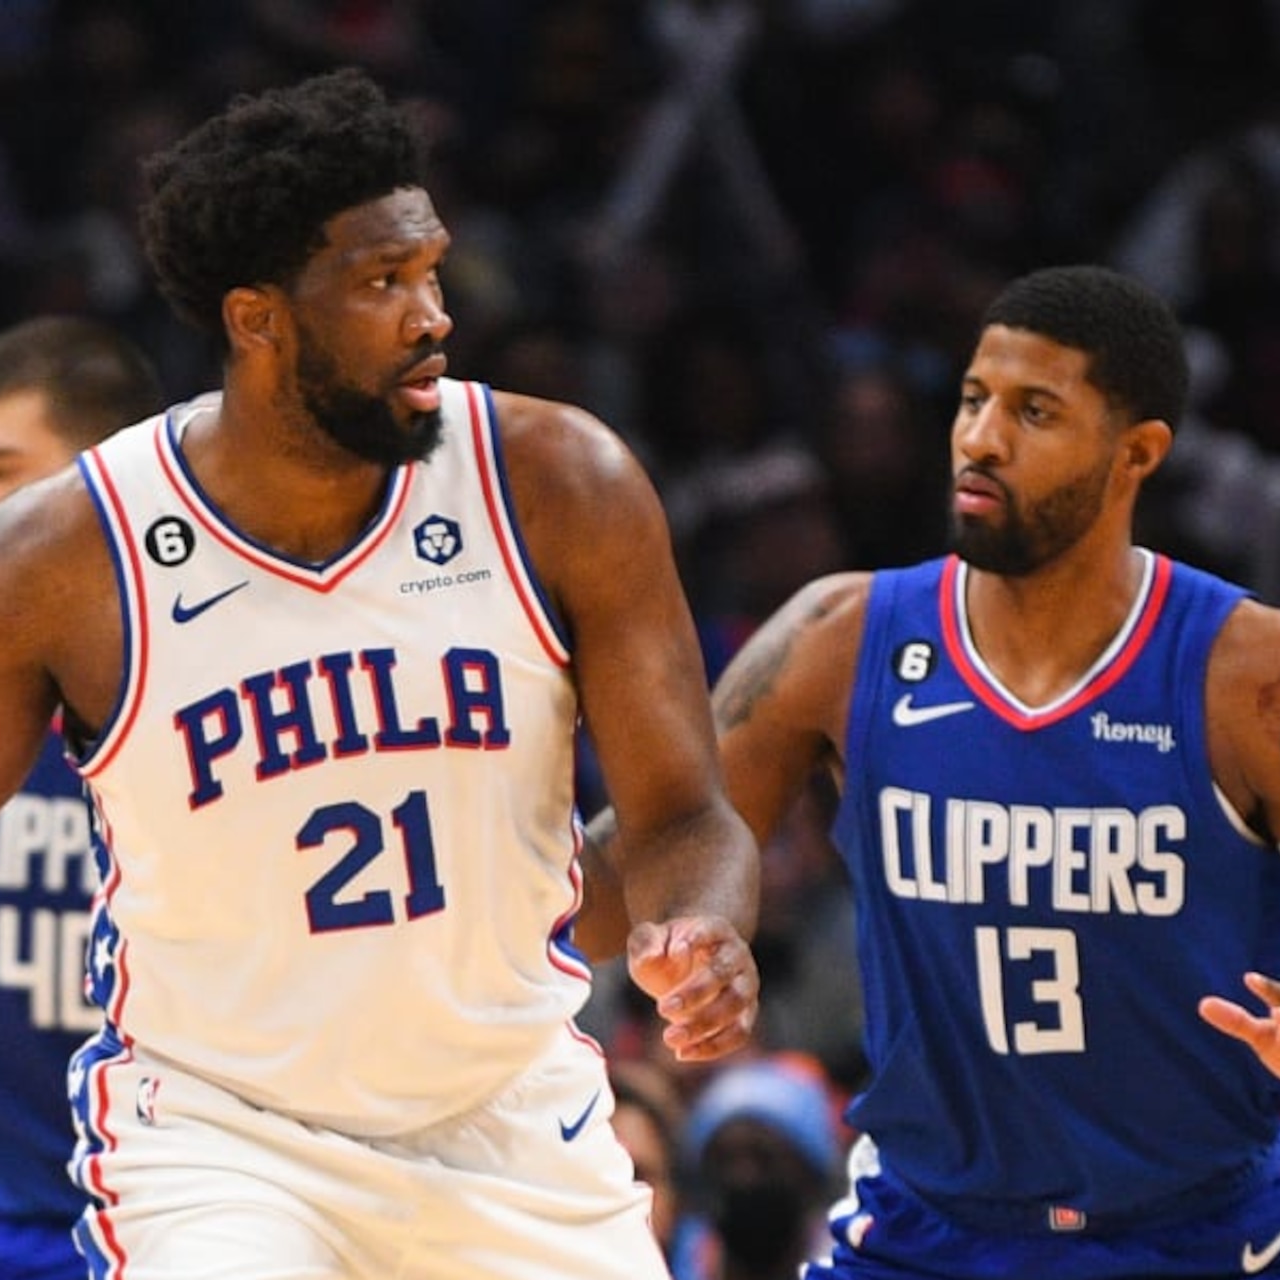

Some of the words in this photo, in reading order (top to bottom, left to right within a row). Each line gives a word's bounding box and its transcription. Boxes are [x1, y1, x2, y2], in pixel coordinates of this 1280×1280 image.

[154, 521, 190, 563] 6
[399, 568, 492, 593] crypto.com
[899, 642, 932, 681] 6
[174, 646, 511, 812] PHILA
[1090, 711, 1177, 753] honey
[295, 789, 446, 935] 21
[877, 786, 1187, 917] CLIPPERS
[974, 925, 1086, 1056] 13
